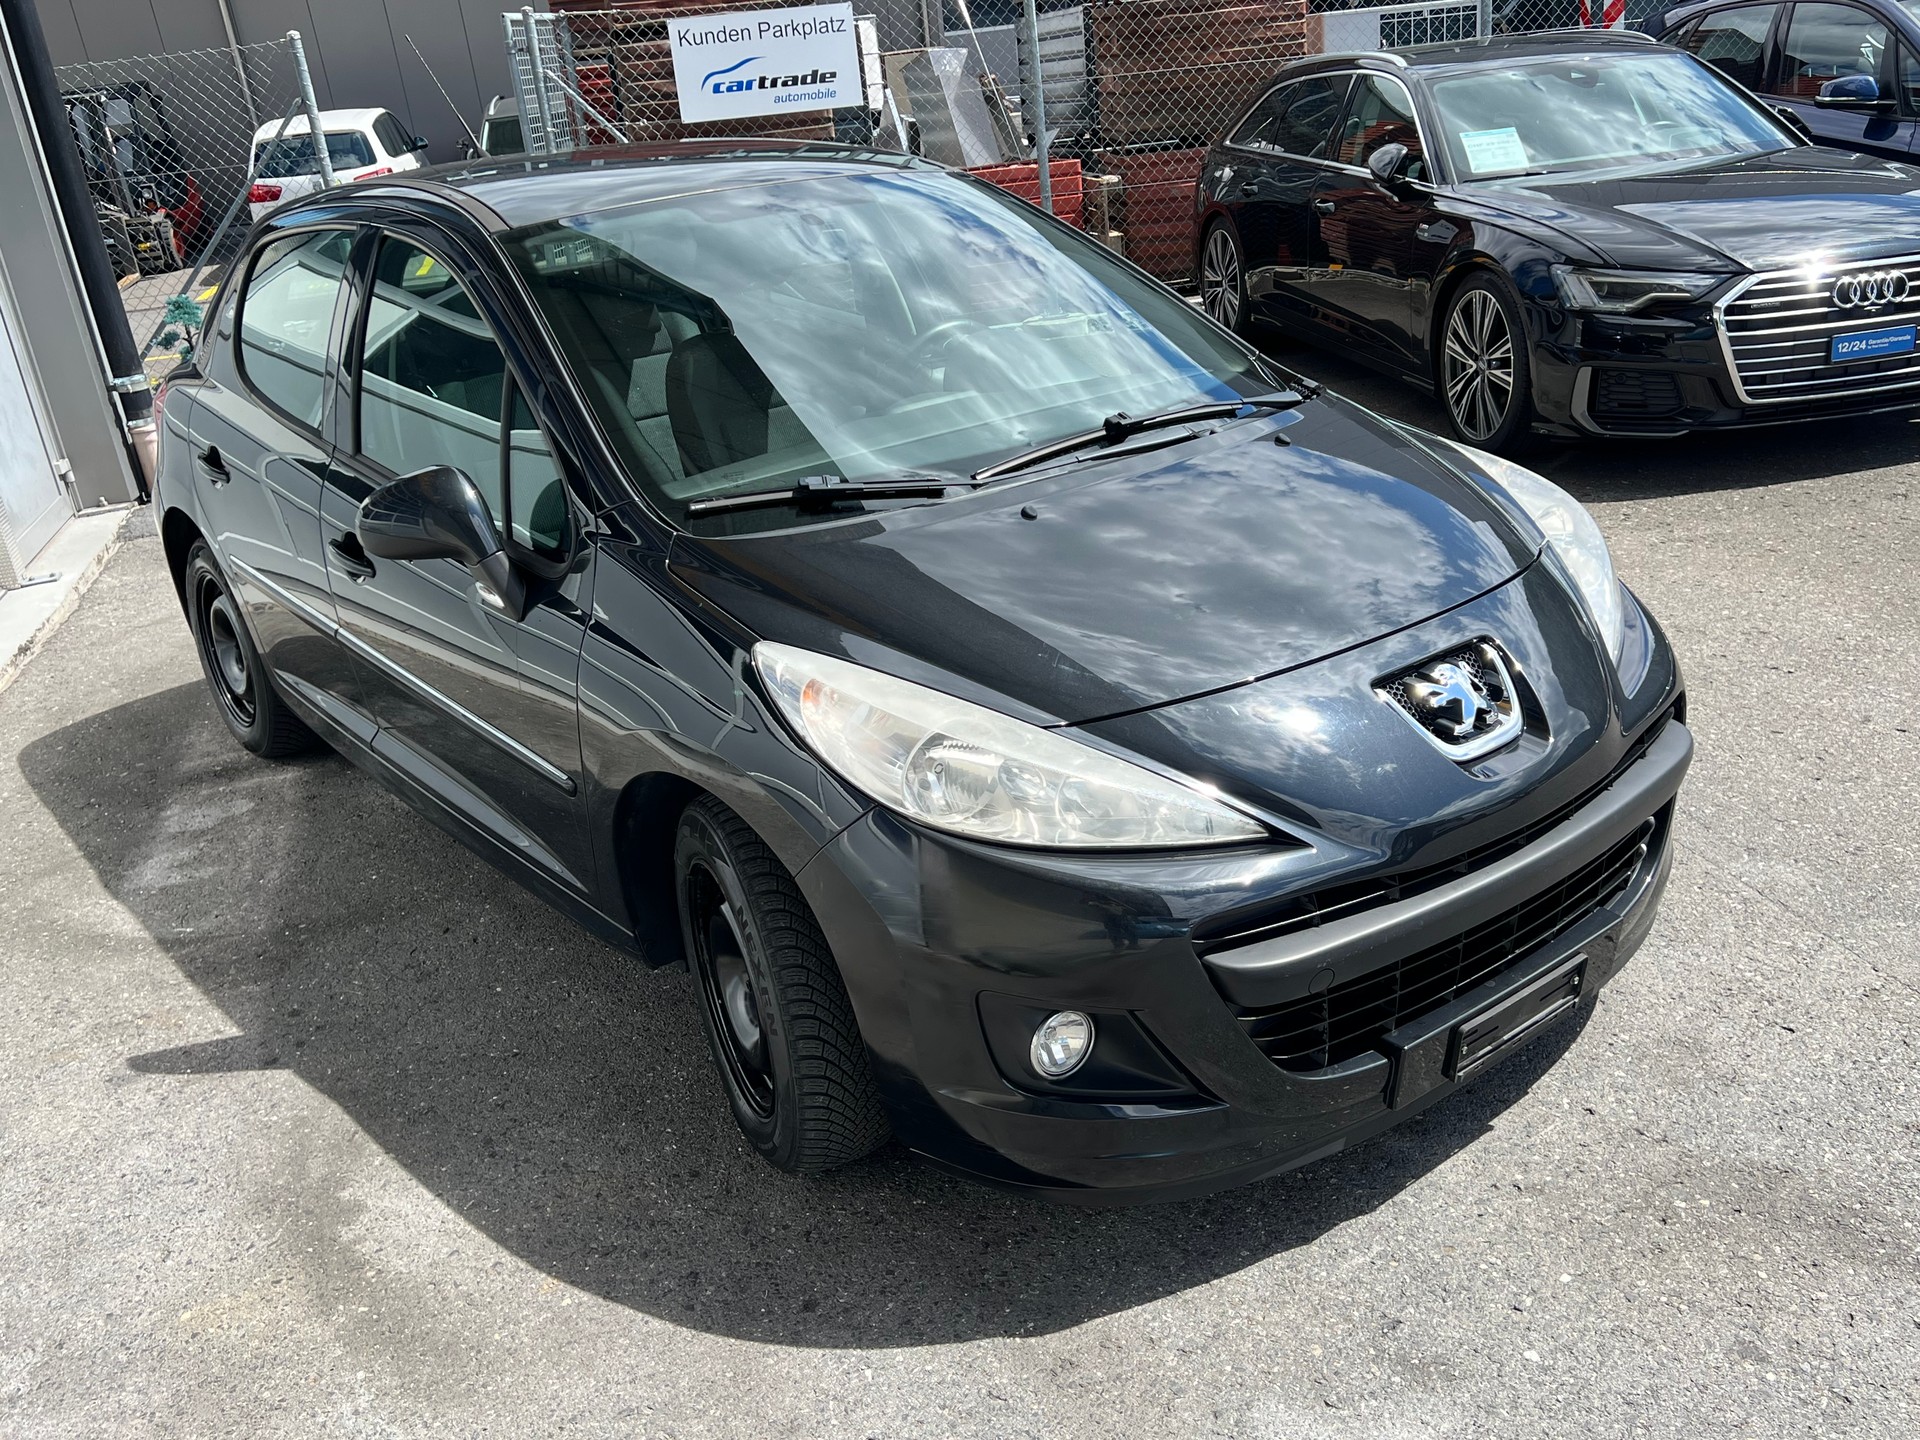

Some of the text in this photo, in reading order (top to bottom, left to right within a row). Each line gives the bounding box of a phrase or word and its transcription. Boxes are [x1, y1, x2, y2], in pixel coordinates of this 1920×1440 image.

[677, 16, 847, 47] Kunden Parkplatz
[712, 69, 837, 94] cartrade
[773, 88, 837, 104] automobile
[1837, 340, 1867, 353] 12/24
[735, 904, 779, 1036] NEXEN
